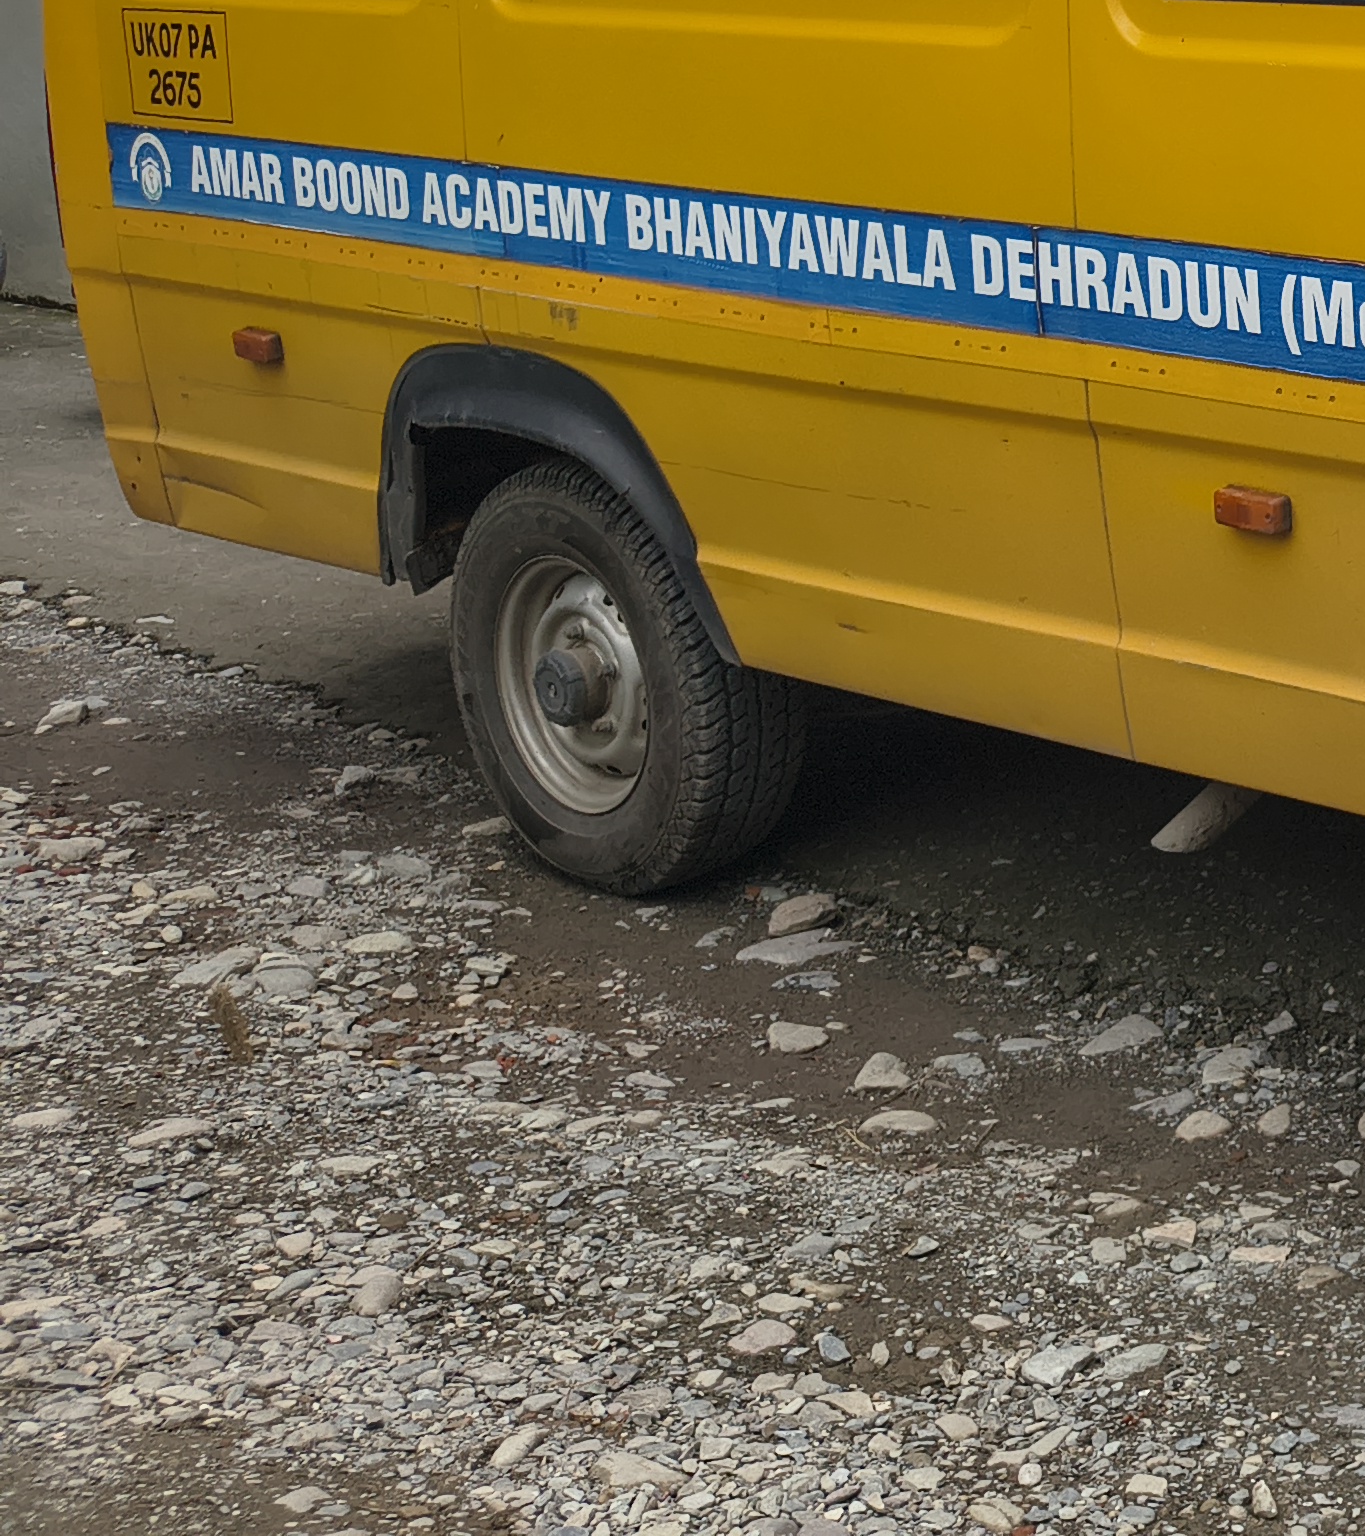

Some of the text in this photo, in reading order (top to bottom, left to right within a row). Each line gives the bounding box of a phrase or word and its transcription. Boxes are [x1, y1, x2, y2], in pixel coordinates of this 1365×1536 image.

[130, 22, 216, 59] UK07 PA
[149, 69, 202, 109] 2675
[191, 145, 286, 204] AMAR
[292, 157, 409, 220] BOOND
[422, 172, 611, 245] ACADEMY
[625, 193, 956, 292] BHANIYAWALA
[971, 233, 1262, 334] DEHRADUN
